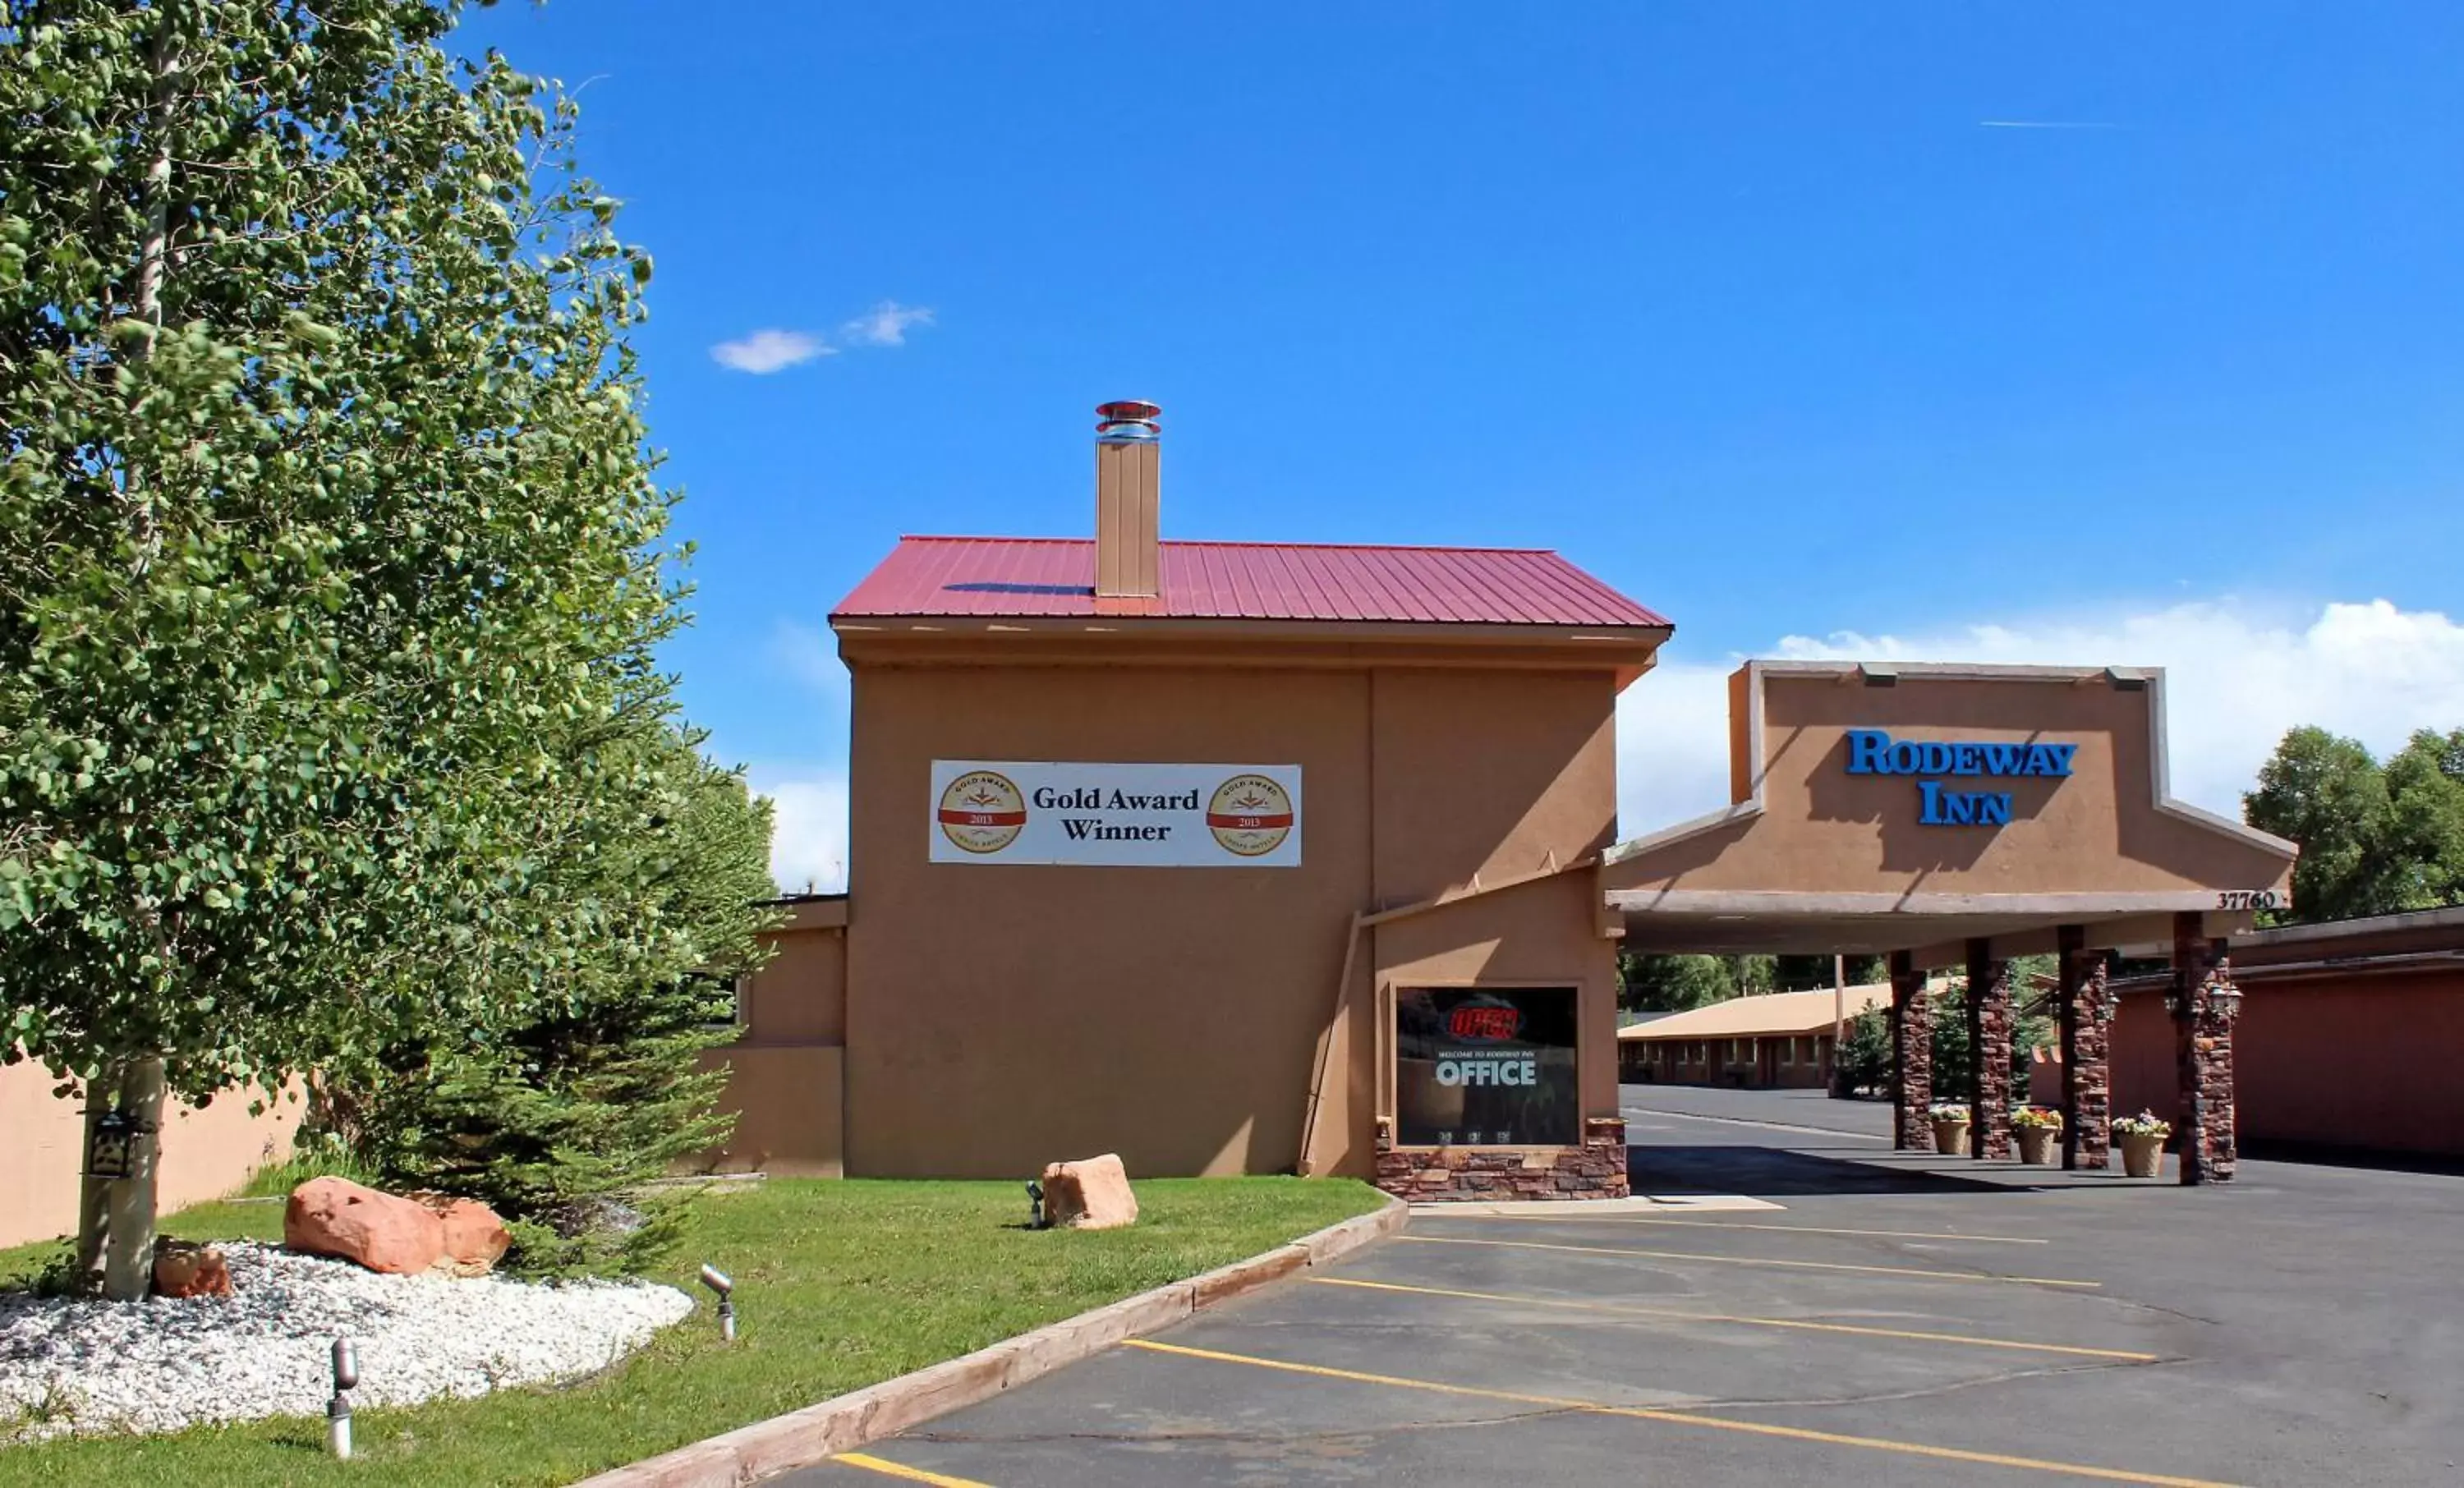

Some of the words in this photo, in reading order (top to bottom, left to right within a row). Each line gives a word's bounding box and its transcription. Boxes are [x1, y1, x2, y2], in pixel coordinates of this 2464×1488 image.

[1845, 727, 2078, 776] RODEWAY
[955, 777, 978, 792] GOLD
[980, 777, 1010, 794] AWARD
[1223, 781, 1247, 797] GOLD
[1249, 781, 1278, 797] AWARD
[1033, 787, 1101, 810] Gold
[1107, 788, 1199, 811] Award
[1916, 781, 2012, 825] INN
[1060, 819, 1172, 840] Winner
[1238, 816, 1262, 827] 2013
[2217, 892, 2275, 909] 37760
[1449, 1008, 1519, 1039] OPEN
[1436, 1060, 1537, 1086] OFFICE
